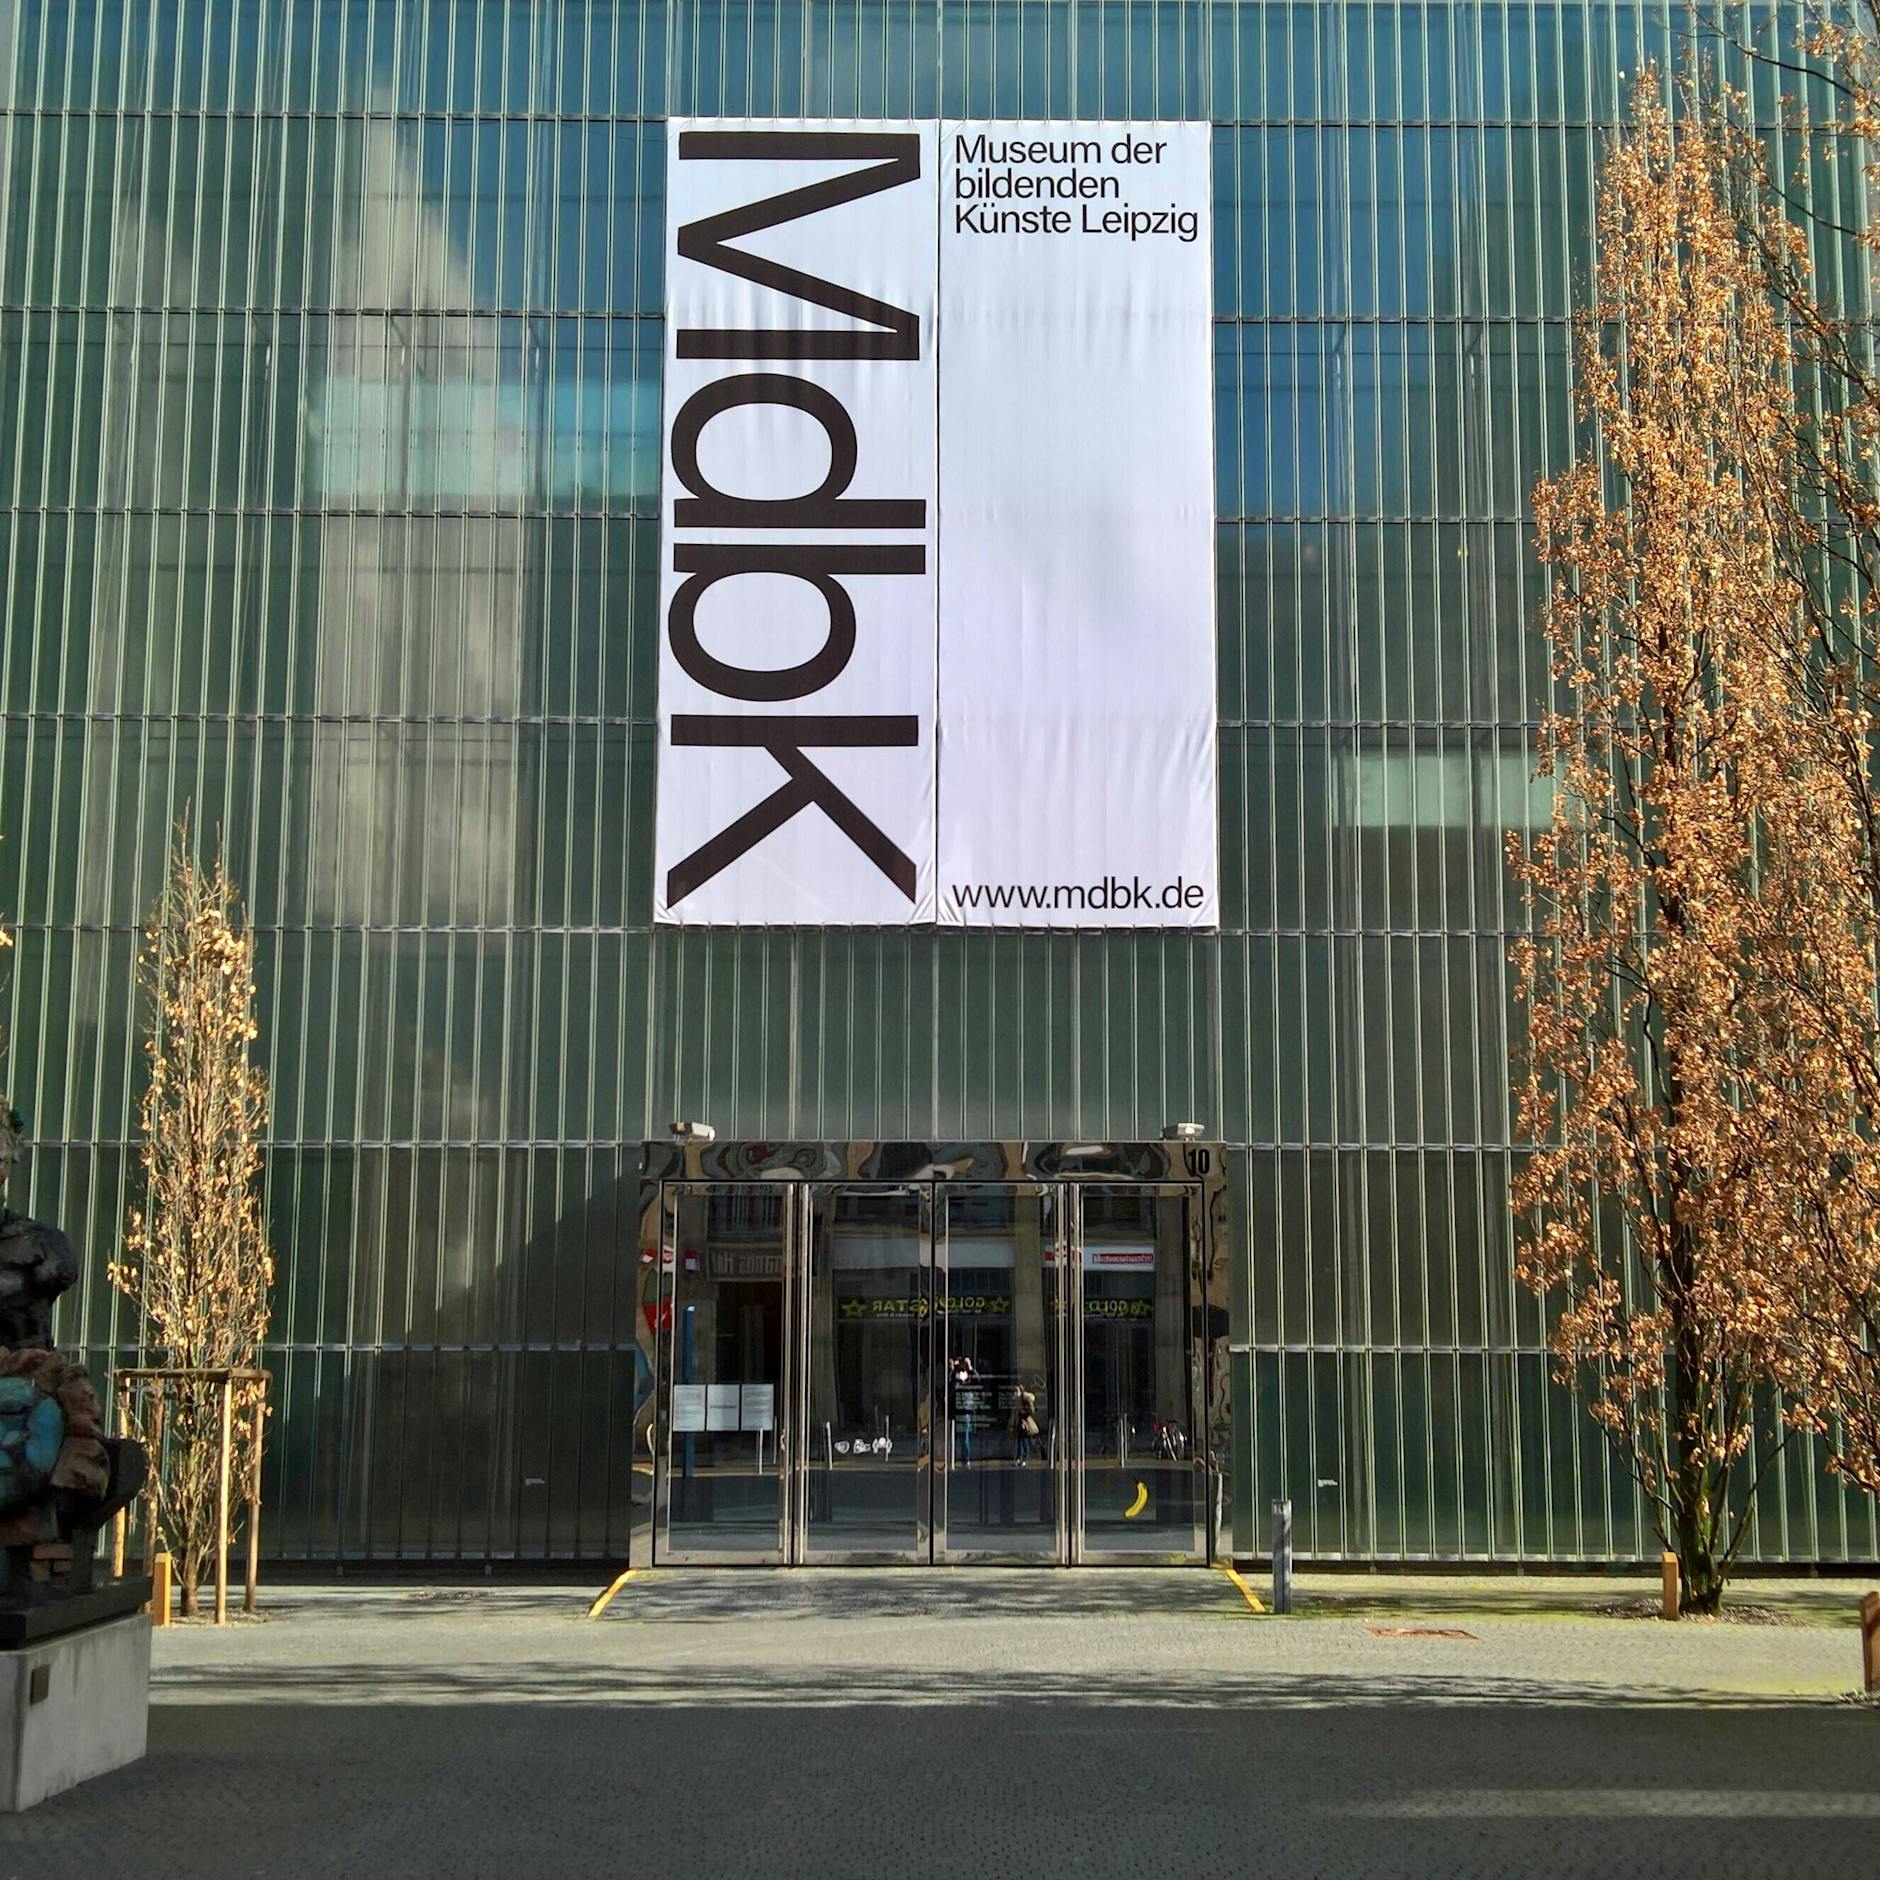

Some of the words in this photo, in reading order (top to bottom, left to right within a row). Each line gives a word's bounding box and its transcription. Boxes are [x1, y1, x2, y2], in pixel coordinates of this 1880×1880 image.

[956, 135, 1101, 164] Museum
[1111, 134, 1168, 164] der
[956, 168, 1119, 199] bildenden
[956, 203, 1072, 234] Künste
[1083, 203, 1198, 242] Leipzig
[667, 131, 926, 909] MdbK
[953, 876, 1204, 909] www.mdbk.de
[1188, 1149, 1209, 1174] 10
